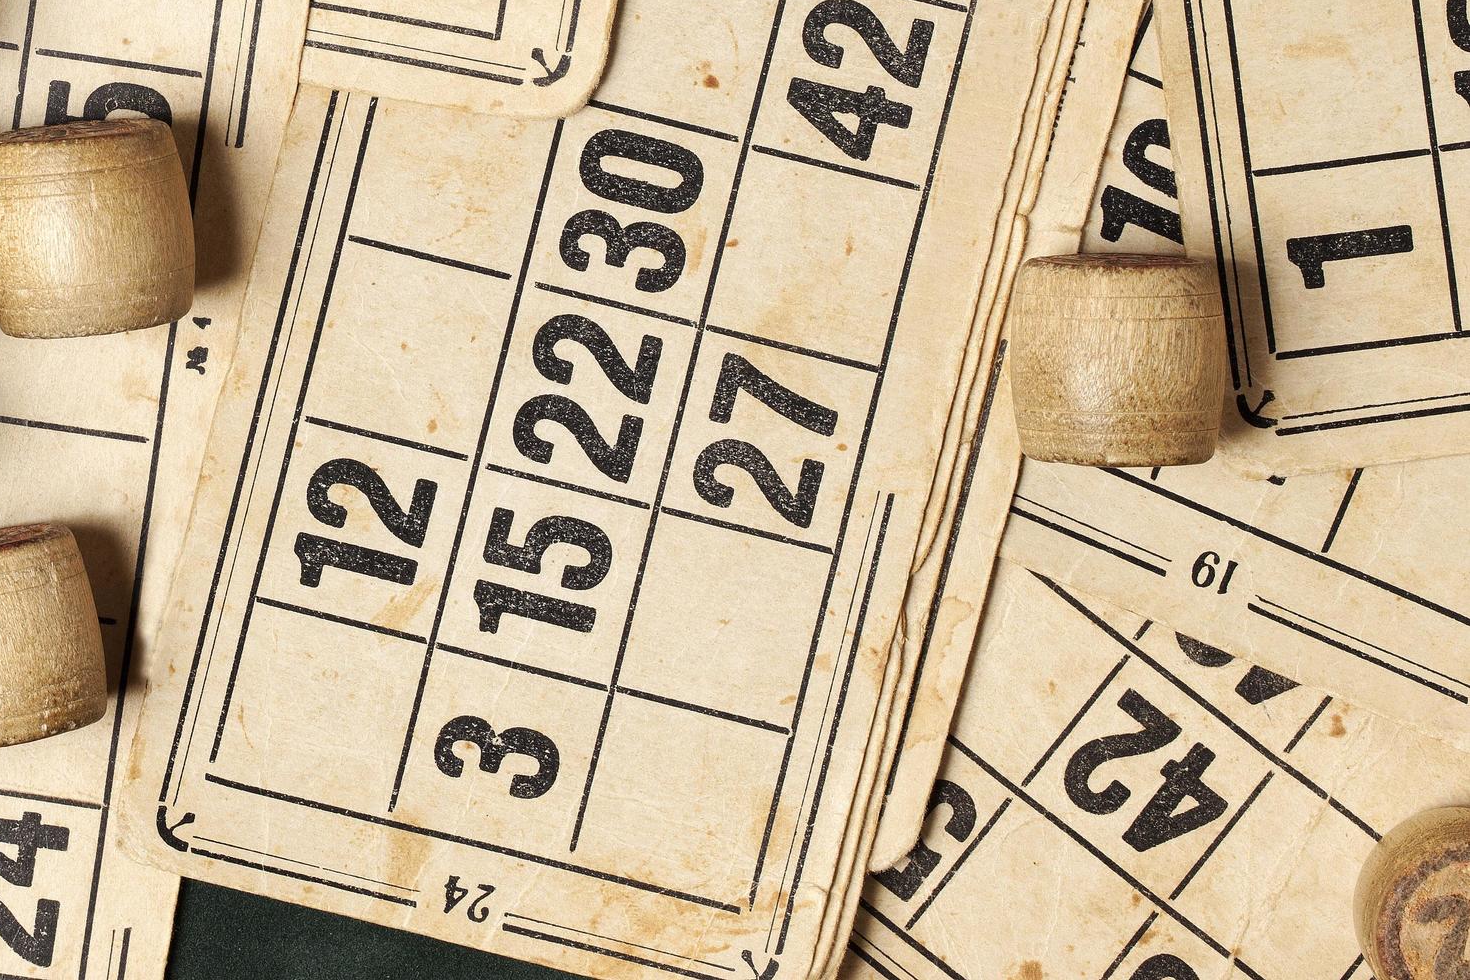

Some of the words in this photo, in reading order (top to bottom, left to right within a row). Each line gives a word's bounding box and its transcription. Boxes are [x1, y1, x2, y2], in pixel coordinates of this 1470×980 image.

[559, 129, 704, 293] 30
[1286, 225, 1414, 289] 1
[512, 314, 664, 484] 22
[693, 353, 839, 529] 27
[294, 459, 438, 587] 12
[474, 507, 613, 634] 15
[434, 715, 560, 800] 3
[1064, 689, 1228, 852] 42
[443, 875, 496, 923] 24
